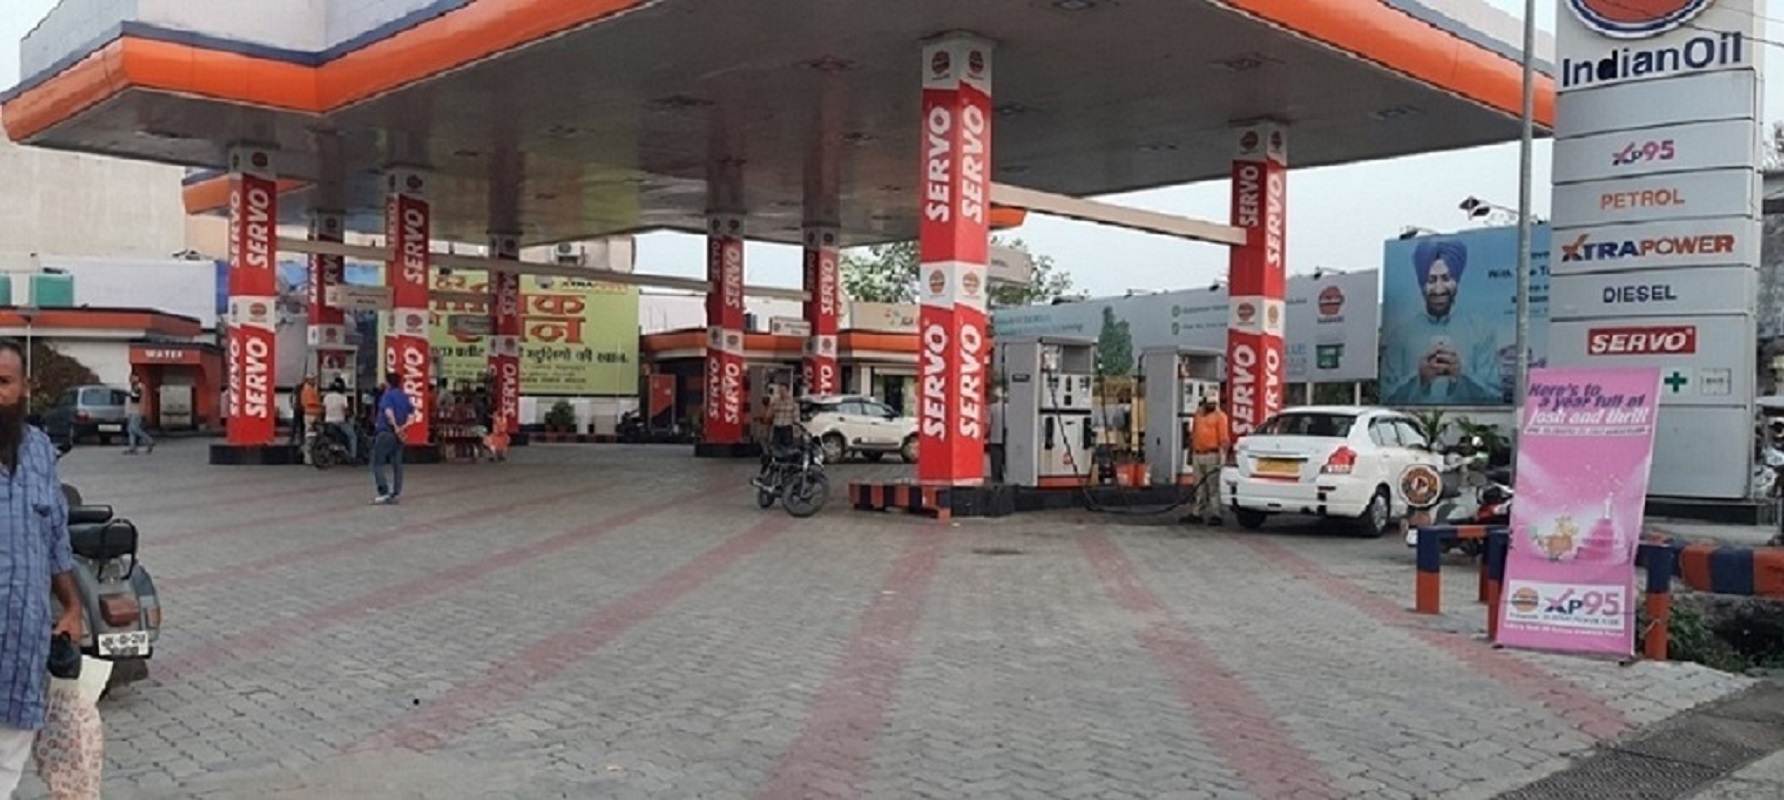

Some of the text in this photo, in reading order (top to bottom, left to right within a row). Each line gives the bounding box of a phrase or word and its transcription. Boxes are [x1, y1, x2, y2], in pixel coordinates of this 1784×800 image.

[1563, 31, 1742, 87] IndianOil
[925, 105, 951, 222] SERVO
[962, 104, 985, 224] SERVO
[1239, 165, 1259, 228] SERVO
[1267, 172, 1282, 268] SERVO
[1601, 188, 1686, 210] PETROL
[246, 188, 268, 269] SERVO
[403, 208, 424, 285] SERVO
[1562, 233, 1736, 263] XTRAPOWER
[725, 247, 741, 309] SERVO
[821, 259, 834, 315] SERVO
[1603, 285, 1678, 303] DIESEL
[245, 336, 268, 418] SERVO
[503, 363, 517, 417] SERVO
[709, 357, 721, 419] SERVO
[724, 362, 741, 424] SERVO
[923, 323, 948, 441] SERVO
[959, 323, 982, 438] SERVO
[1232, 344, 1257, 437] SERVO
[1529, 382, 1601, 397] Here's to
[1538, 393, 1646, 412] a year full of
[1568, 407, 1605, 425] and
[1605, 407, 1649, 425] thrill
[1544, 588, 1620, 617] XP95
